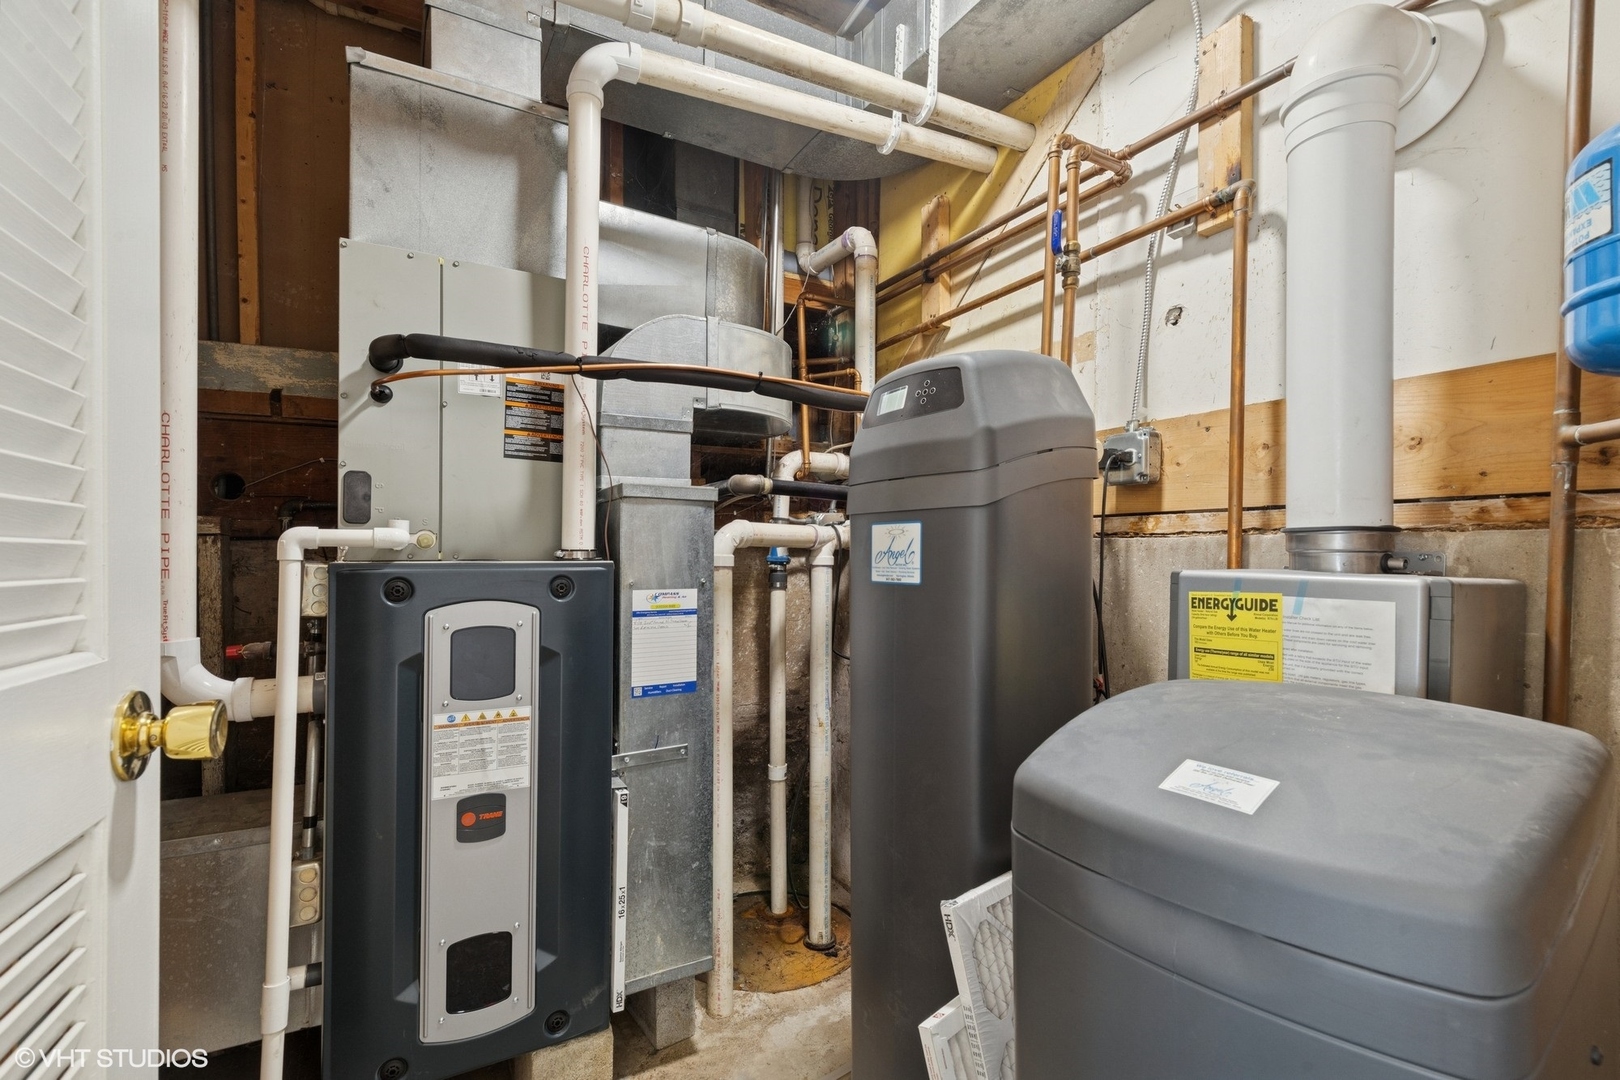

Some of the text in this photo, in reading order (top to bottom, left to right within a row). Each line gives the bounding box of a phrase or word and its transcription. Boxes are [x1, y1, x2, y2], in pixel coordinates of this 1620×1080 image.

[582, 246, 590, 331] CHARLOTTE
[161, 412, 170, 519] CHARLOTTE
[161, 533, 170, 580] PIPE
[1191, 597, 1278, 612] ENERGYGUIDE
[479, 810, 503, 820] TRANE
[944, 913, 955, 938] HDX
